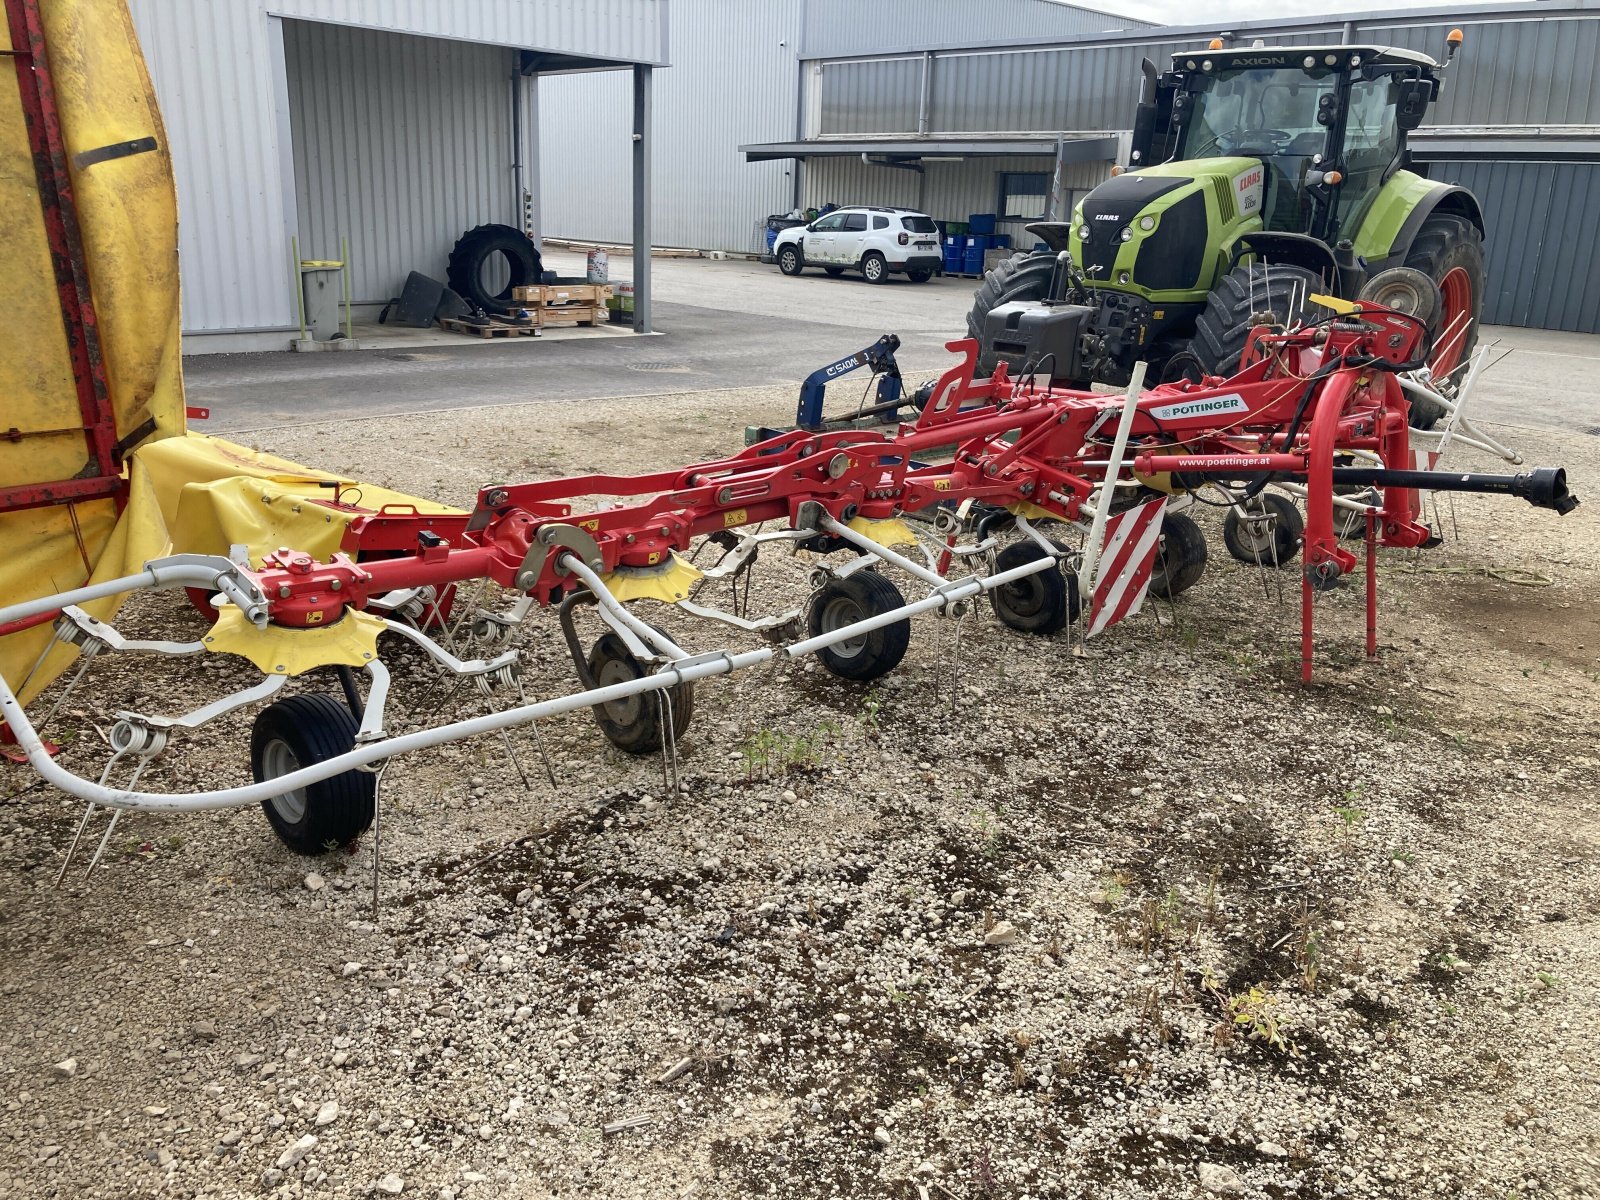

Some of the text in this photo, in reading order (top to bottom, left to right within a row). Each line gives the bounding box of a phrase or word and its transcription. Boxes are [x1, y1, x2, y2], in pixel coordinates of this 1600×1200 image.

[1231, 56, 1285, 66] AXION
[1239, 171, 1261, 192] CLAAS
[1178, 457, 1270, 467] www.poettinger.at
